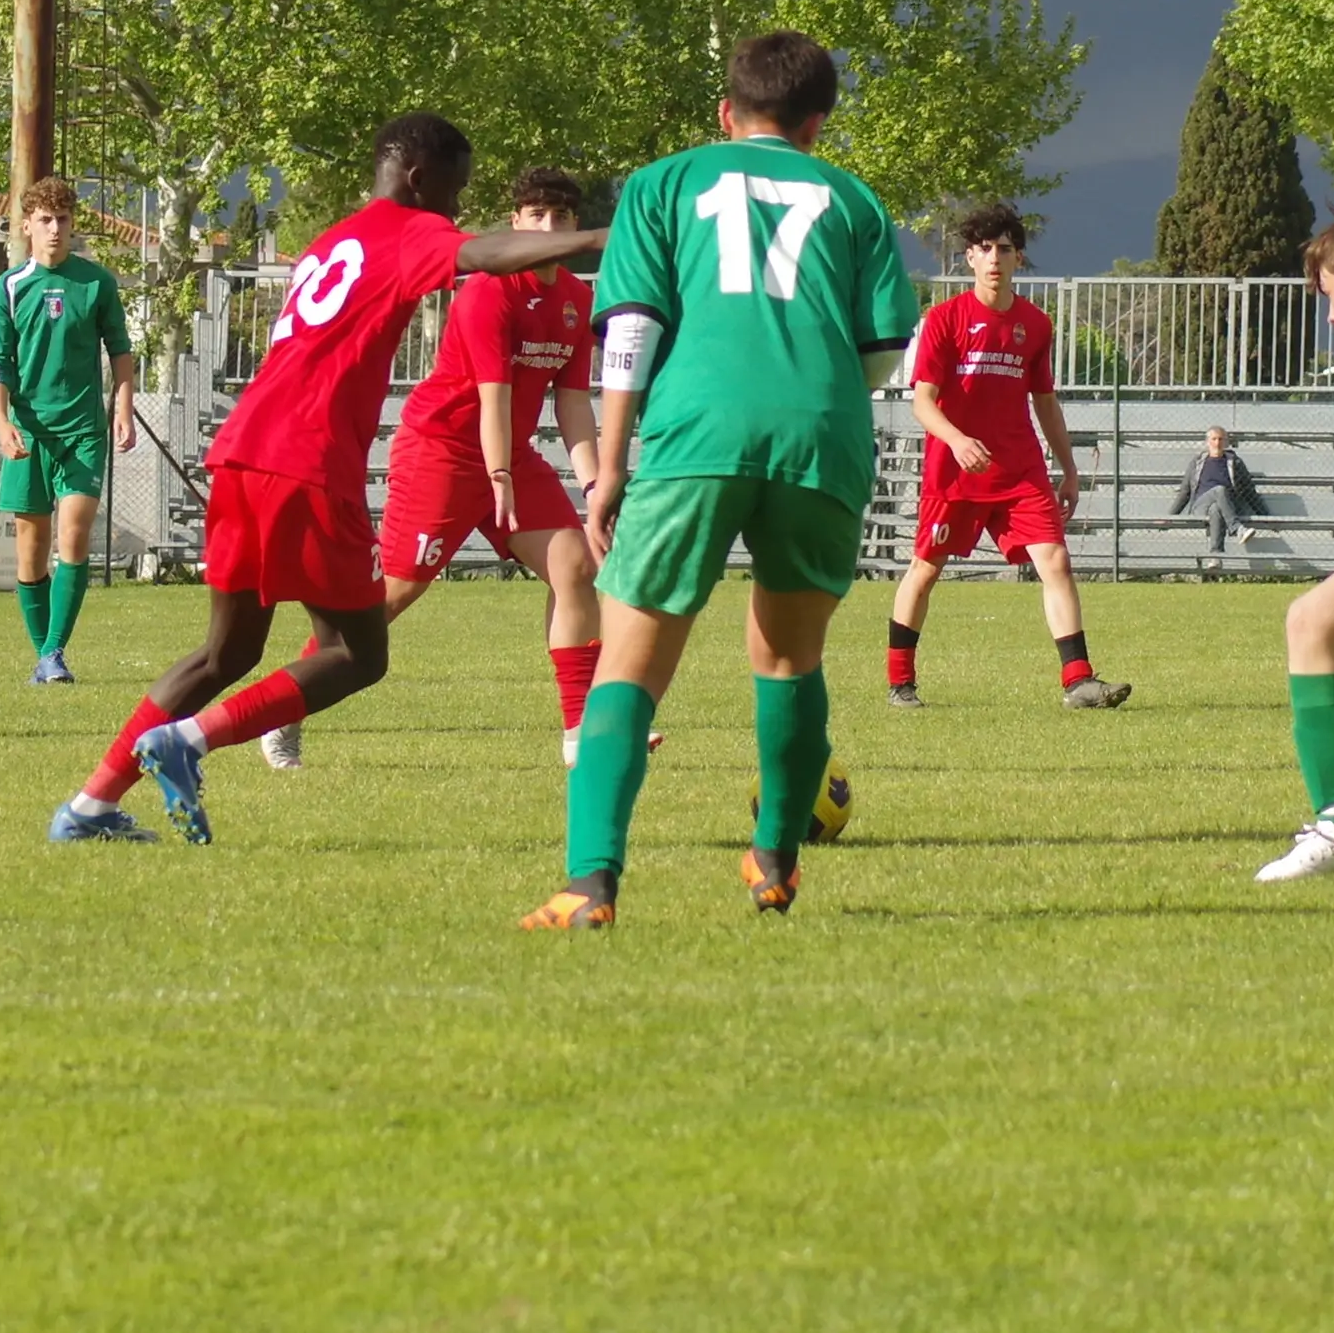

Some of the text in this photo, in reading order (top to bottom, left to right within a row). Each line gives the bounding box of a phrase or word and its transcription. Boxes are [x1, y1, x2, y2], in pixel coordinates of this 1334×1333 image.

[695, 171, 830, 301] 17
[271, 238, 365, 348] 20
[606, 351, 633, 370] 2016
[415, 532, 444, 567] 16
[931, 523, 950, 547] 10
